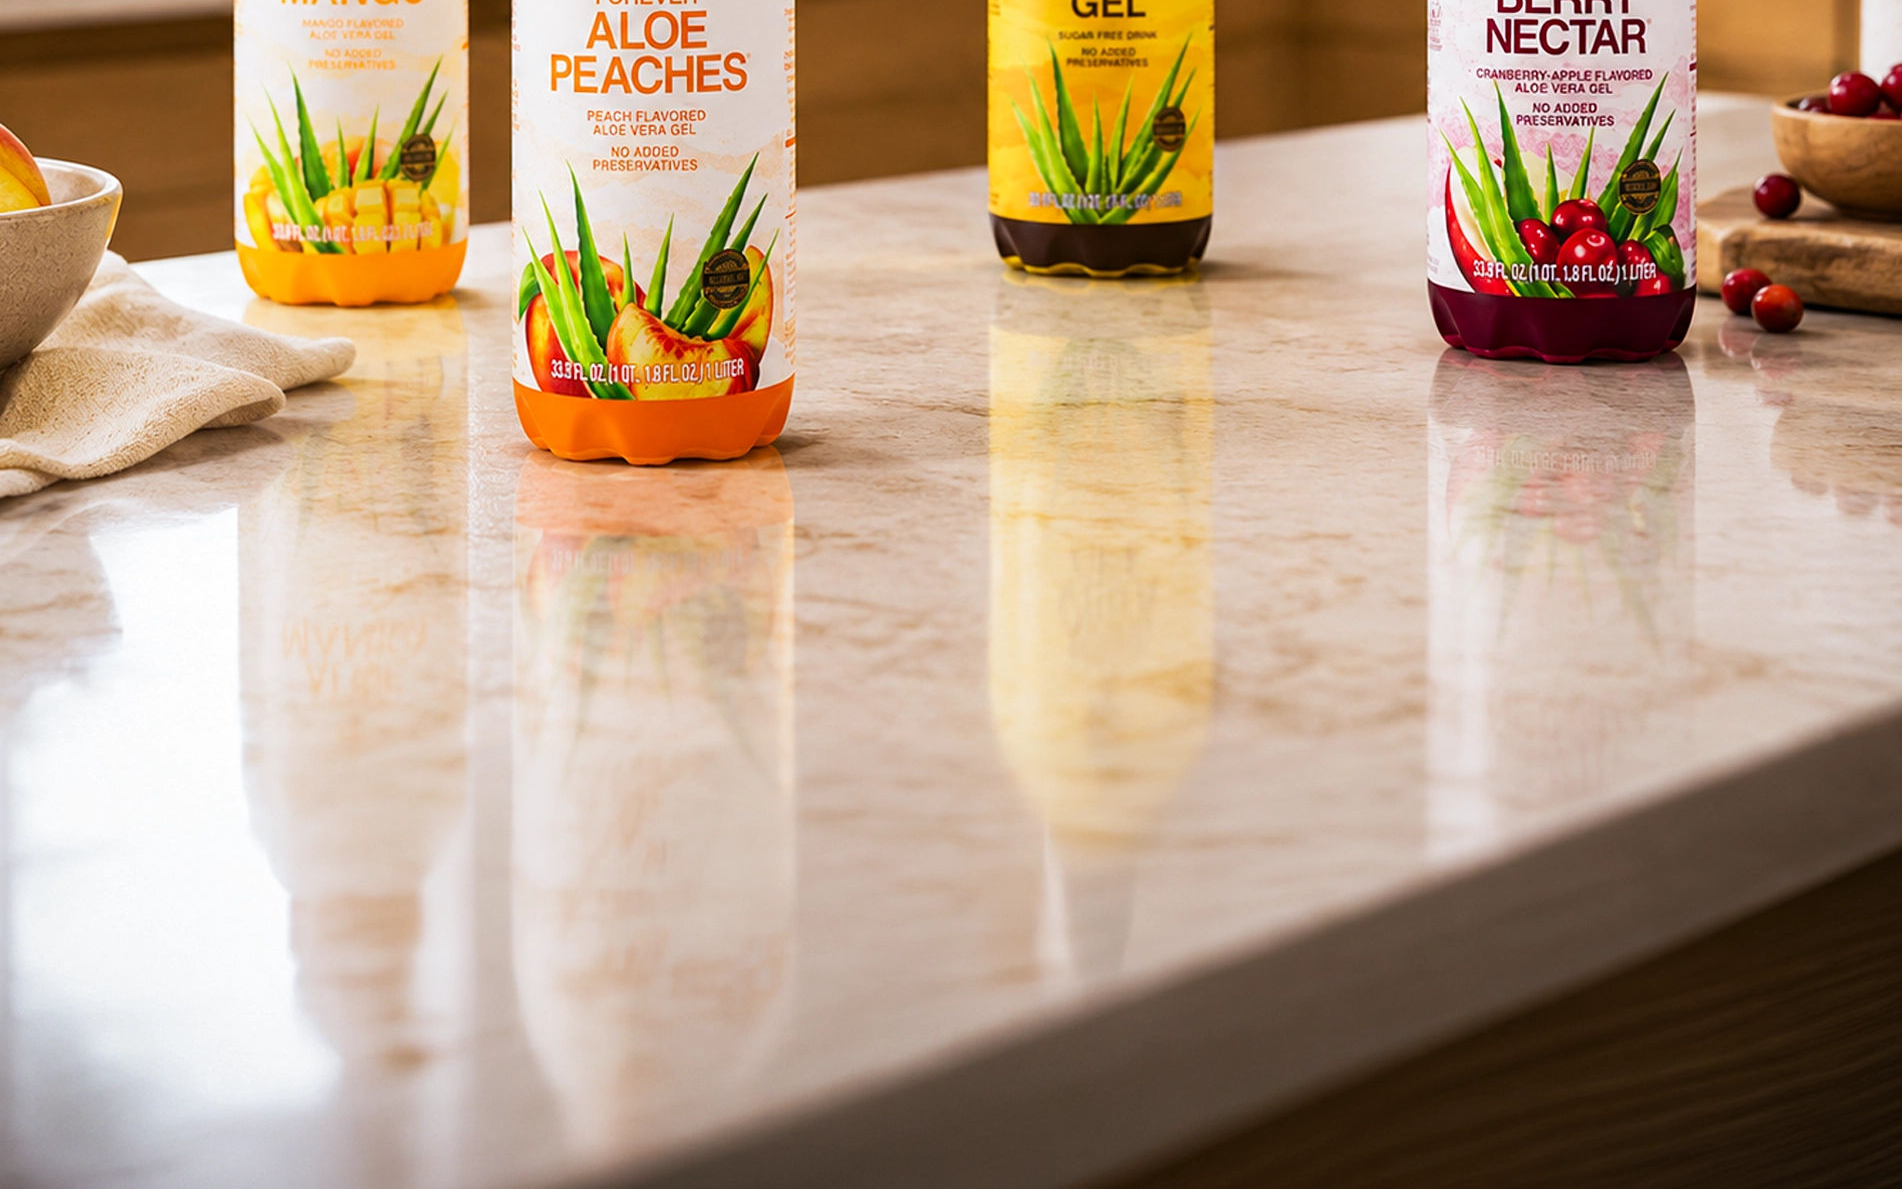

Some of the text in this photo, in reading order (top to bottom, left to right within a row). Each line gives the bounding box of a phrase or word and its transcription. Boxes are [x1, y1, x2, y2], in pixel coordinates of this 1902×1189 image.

[302, 18, 404, 28] MANGO FLAVORED
[309, 31, 337, 40] ALOE
[586, 10, 708, 50] ALOE
[1058, 31, 1157, 40] SUGAR FREE DRINK
[1486, 17, 1646, 56] NECTAR
[325, 49, 381, 58] NO ADDED
[1081, 48, 1136, 57] NO ADDED
[308, 60, 396, 70] PRESERVATIVES
[1066, 58, 1148, 68] PRESERVATIVES
[551, 52, 748, 94] PEACHES
[1476, 68, 1653, 82] CRANBERRY-APPLE FLAVORED
[1515, 83, 1613, 94] ALOE VERA GEL
[1532, 103, 1598, 114] NO ADDED
[587, 110, 706, 122] PEACH FLAVORED
[1516, 114, 1615, 127] PRESERVATIVES
[593, 123, 696, 136] ALOE VERA GEL
[611, 146, 679, 158] NO ADDED
[593, 159, 698, 172] PRESERVATIVES
[1563, 264, 1580, 282] 1.8
[715, 358, 744, 379] LITER
